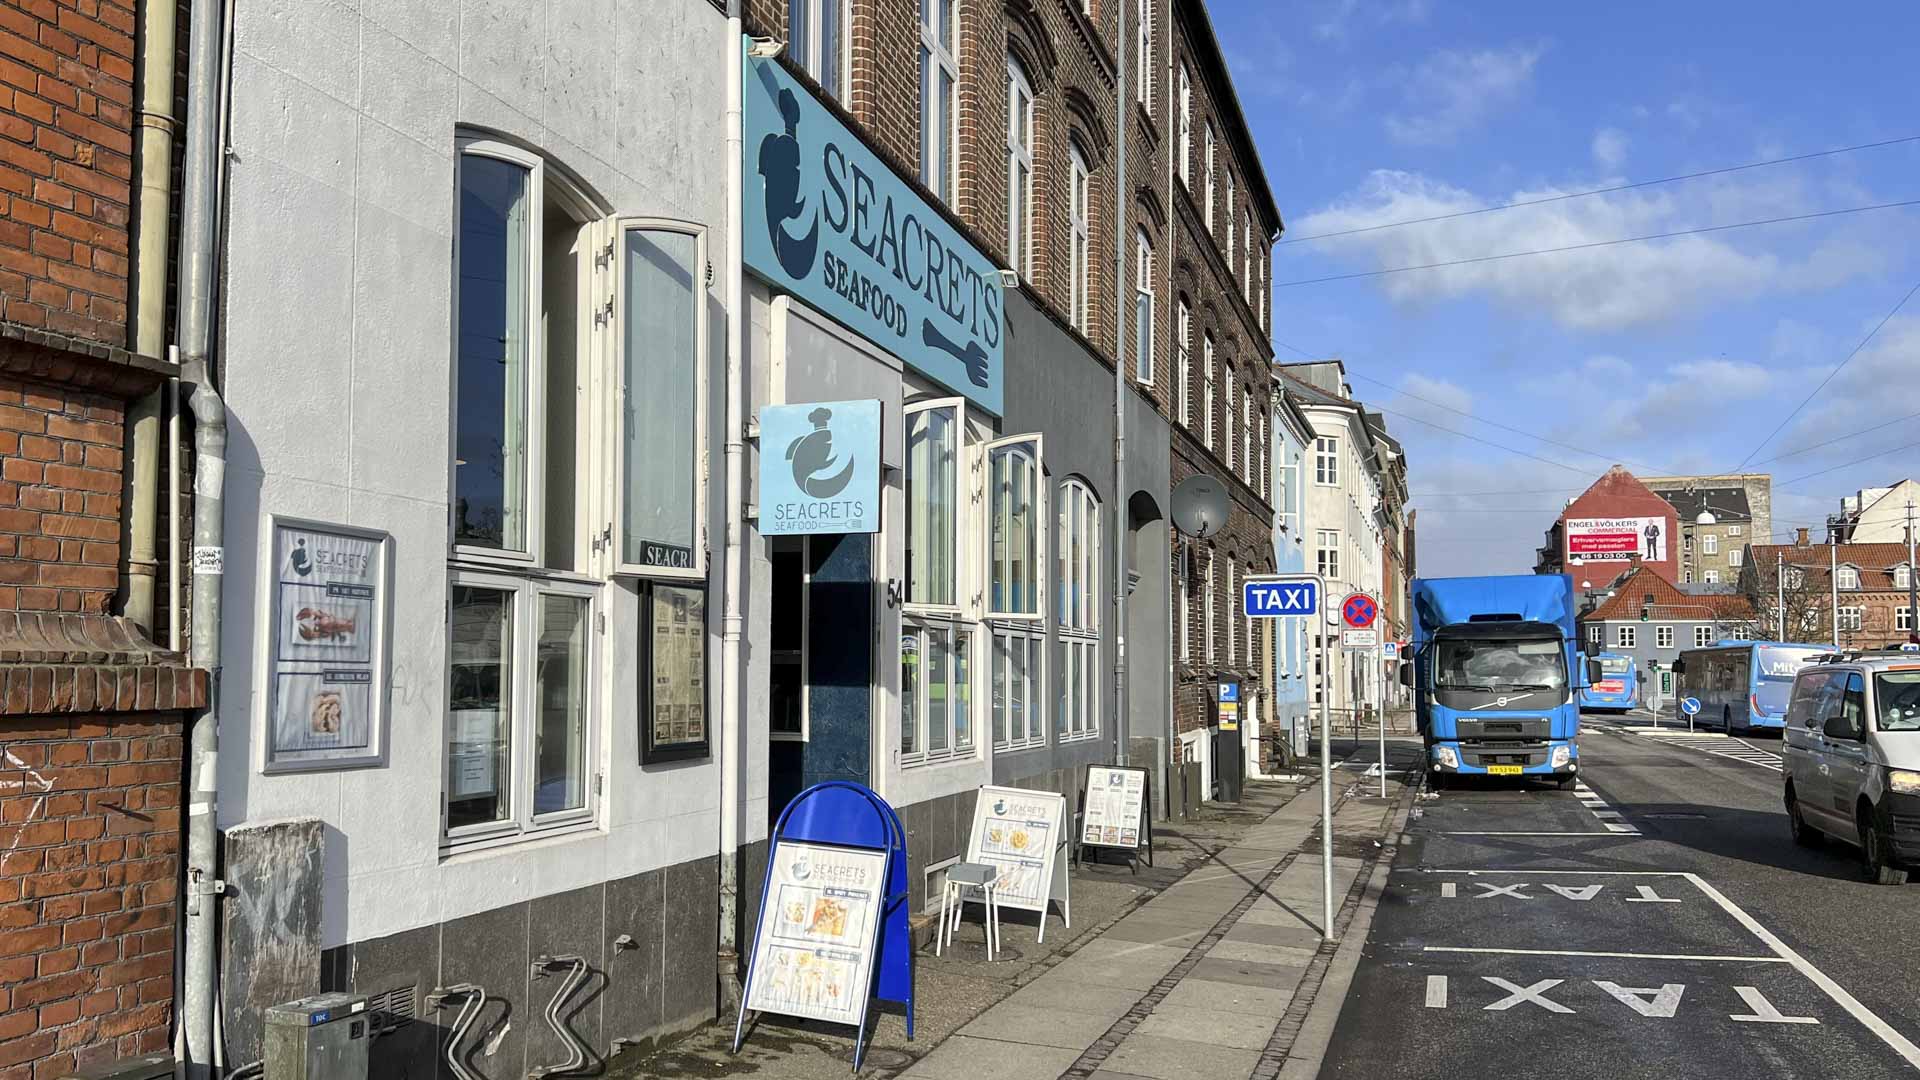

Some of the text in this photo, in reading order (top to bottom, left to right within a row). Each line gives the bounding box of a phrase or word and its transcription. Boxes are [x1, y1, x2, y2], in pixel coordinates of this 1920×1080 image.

[822, 142, 999, 349] SEACRETS
[823, 250, 908, 338] SEAFOOD
[775, 501, 864, 520] SEACRETS
[775, 520, 818, 531] SEAFOOD
[316, 549, 369, 569] SEACRETS
[887, 578, 903, 611] 54
[1251, 588, 1310, 610] TAXI
[1220, 684, 1230, 697] P
[814, 863, 867, 879] SEACRETS
[1442, 882, 1682, 903] TAXI
[1425, 975, 1821, 1024] TAXI
